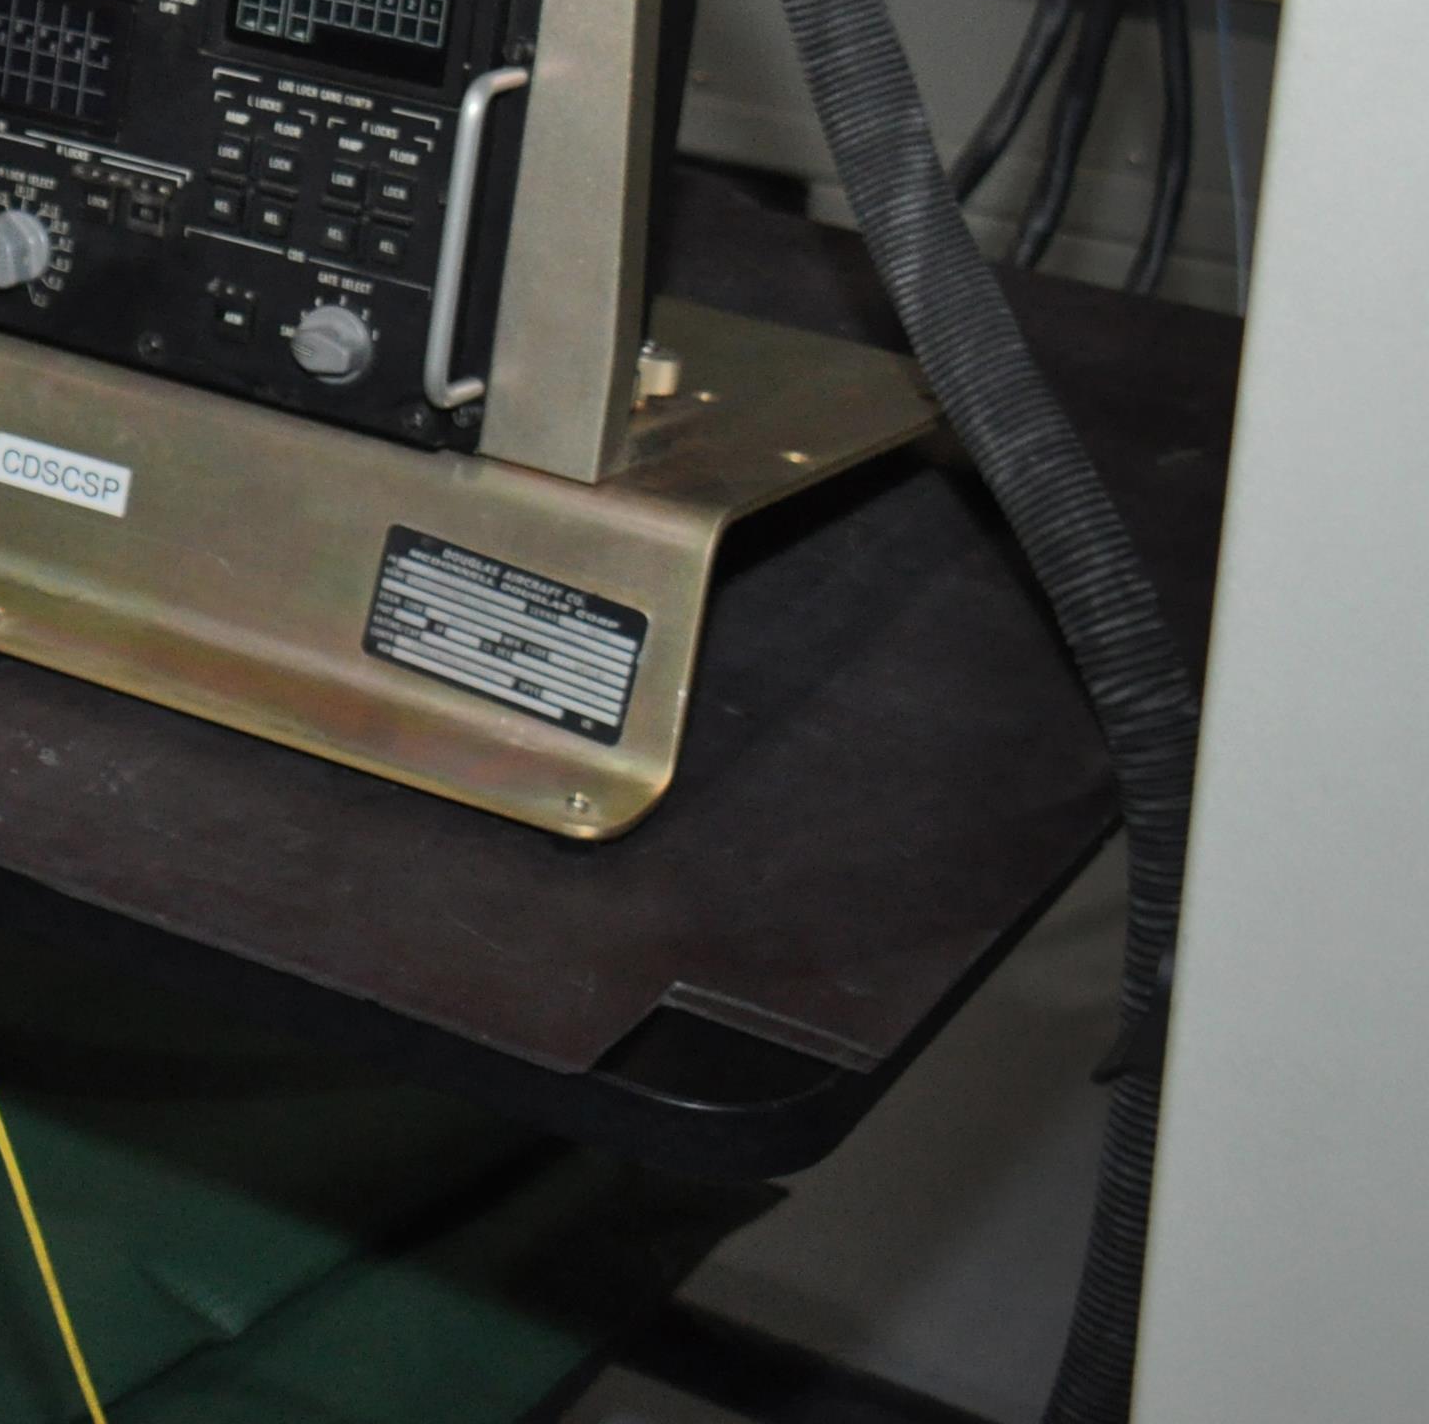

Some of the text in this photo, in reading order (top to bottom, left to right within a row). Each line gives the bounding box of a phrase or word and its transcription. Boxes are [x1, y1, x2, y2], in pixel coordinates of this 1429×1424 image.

[296, 83, 318, 98] LOCK
[274, 121, 303, 138] FLOOR
[370, 124, 400, 140] LOCKS
[218, 145, 241, 160] LOCK
[389, 148, 419, 166] FLOOR
[269, 156, 291, 172] LOCK
[331, 172, 356, 188] LOCK
[383, 185, 408, 200] LOCK
[263, 210, 280, 225] REL
[379, 239, 396, 255] REL
[341, 277, 373, 294] SELECT
[2, 448, 120, 502] CDSCSP
[442, 547, 500, 577] DOUGLAS
[502, 571, 563, 598] AIRCRAFT
[500, 581, 572, 613] DOUGLAS
